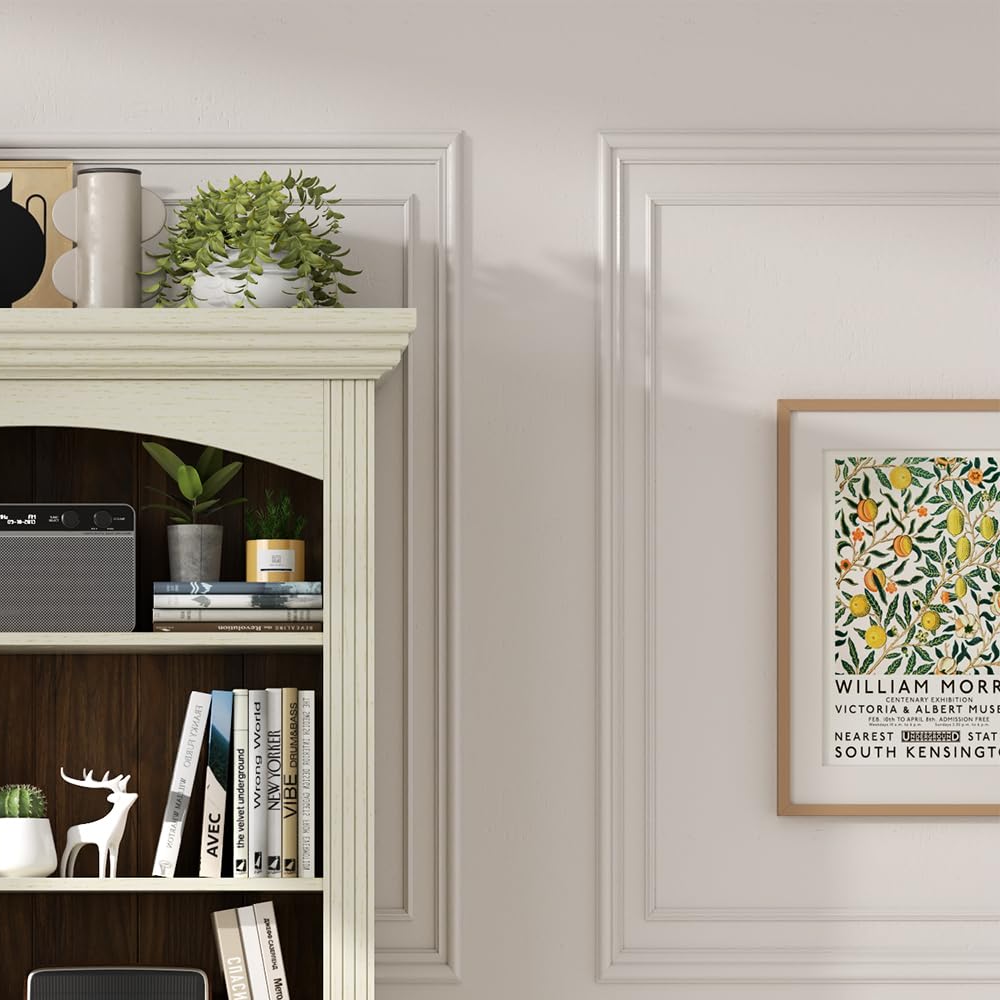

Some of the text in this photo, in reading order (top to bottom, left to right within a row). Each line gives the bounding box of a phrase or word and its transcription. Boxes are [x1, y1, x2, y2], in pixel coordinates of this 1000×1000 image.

[836, 680, 928, 693] WILLIAM
[836, 705, 897, 713] VICTORIA
[916, 705, 962, 713] ALBERT
[835, 732, 894, 741] NEAREST
[902, 731, 960, 742] UNDERGROUND
[836, 747, 1000, 758] SOUTH KENSINGT
[254, 755, 262, 809] Wrong
[268, 730, 281, 810] NEW YORKER
[237, 749, 246, 848] the velvet underground
[284, 775, 297, 818] VIBE
[207, 813, 220, 857] AVEC
